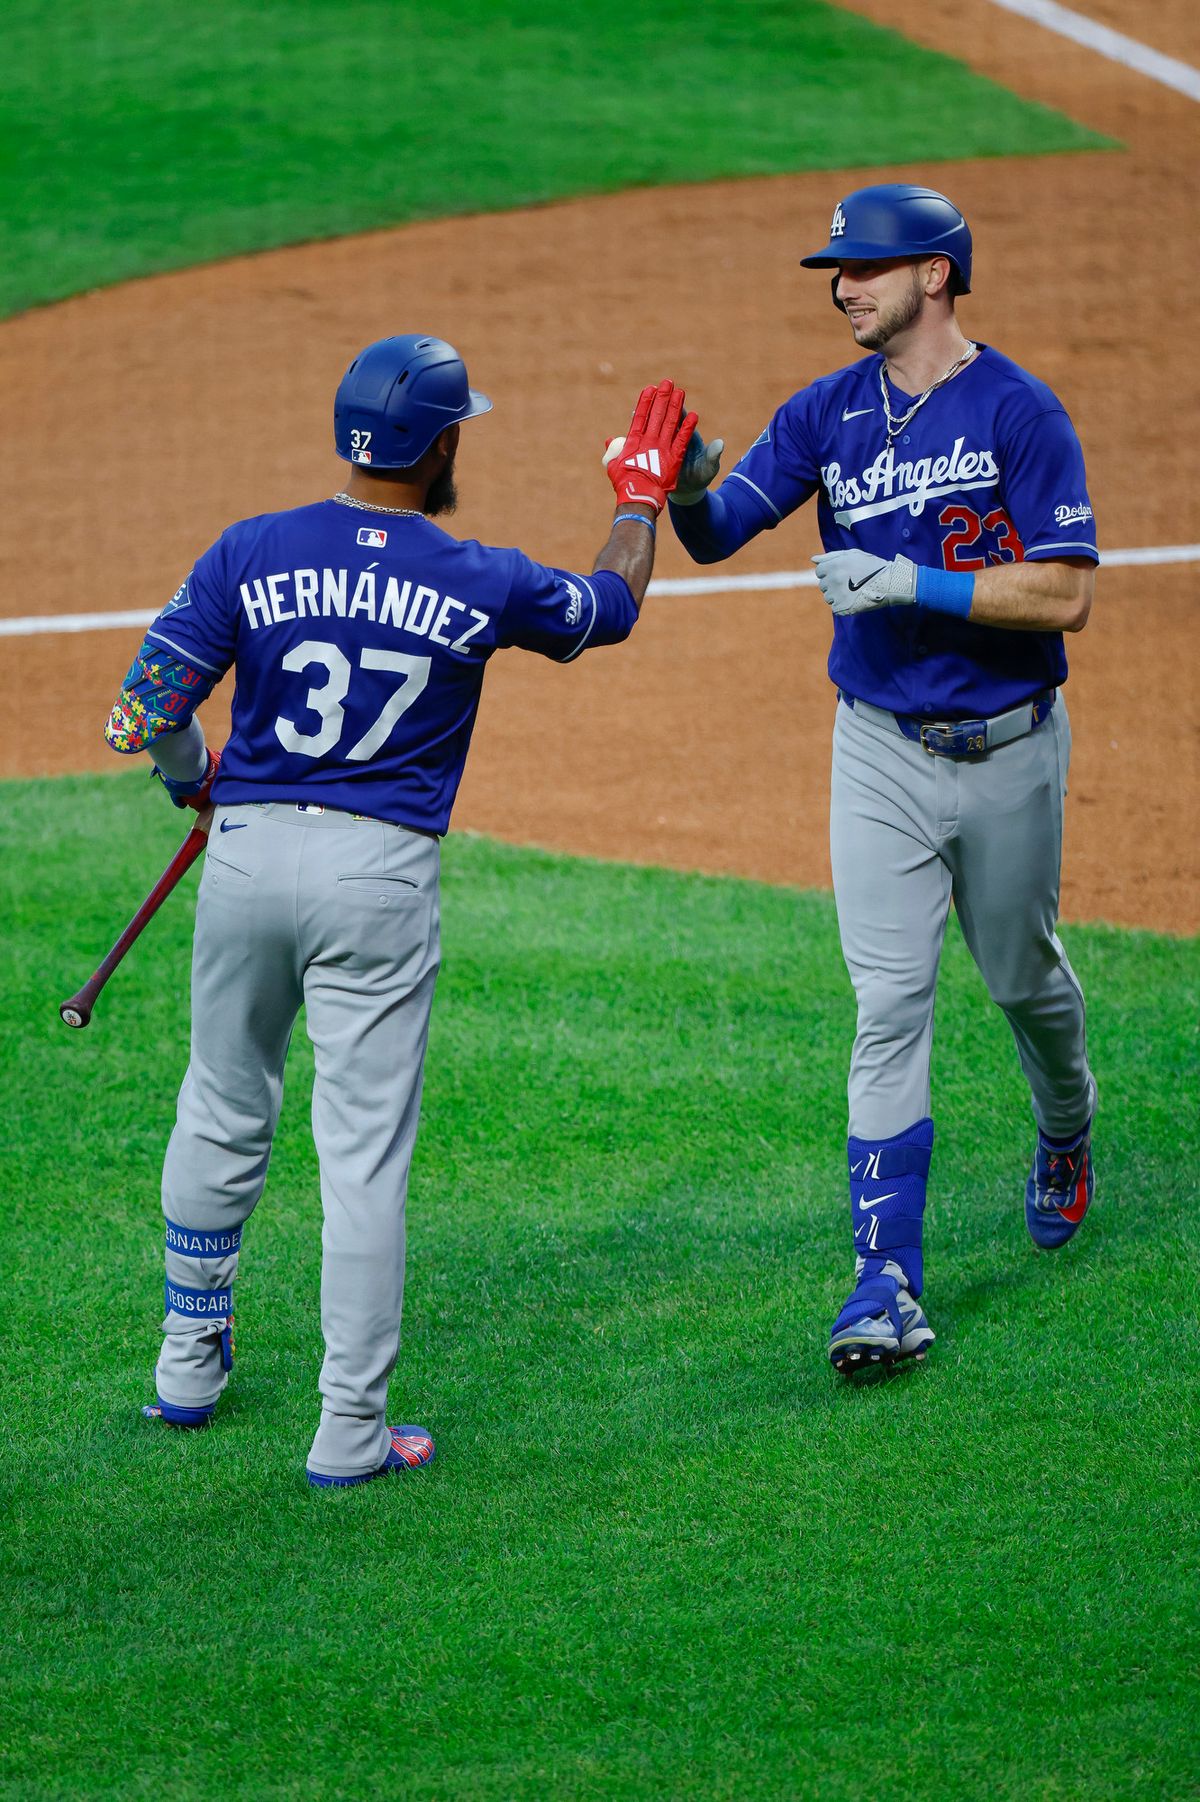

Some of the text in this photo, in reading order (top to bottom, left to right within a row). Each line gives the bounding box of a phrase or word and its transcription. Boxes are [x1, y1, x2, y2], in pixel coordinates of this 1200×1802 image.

[831, 202, 846, 237] LA
[350, 429, 372, 449] 37
[820, 436, 1000, 517] Los Angeles
[938, 504, 1025, 573] 23
[240, 562, 490, 654] HERNÁNDEZ
[164, 693, 189, 715] 37
[274, 640, 432, 761] 37
[168, 1286, 229, 1312] TEOSCAR
